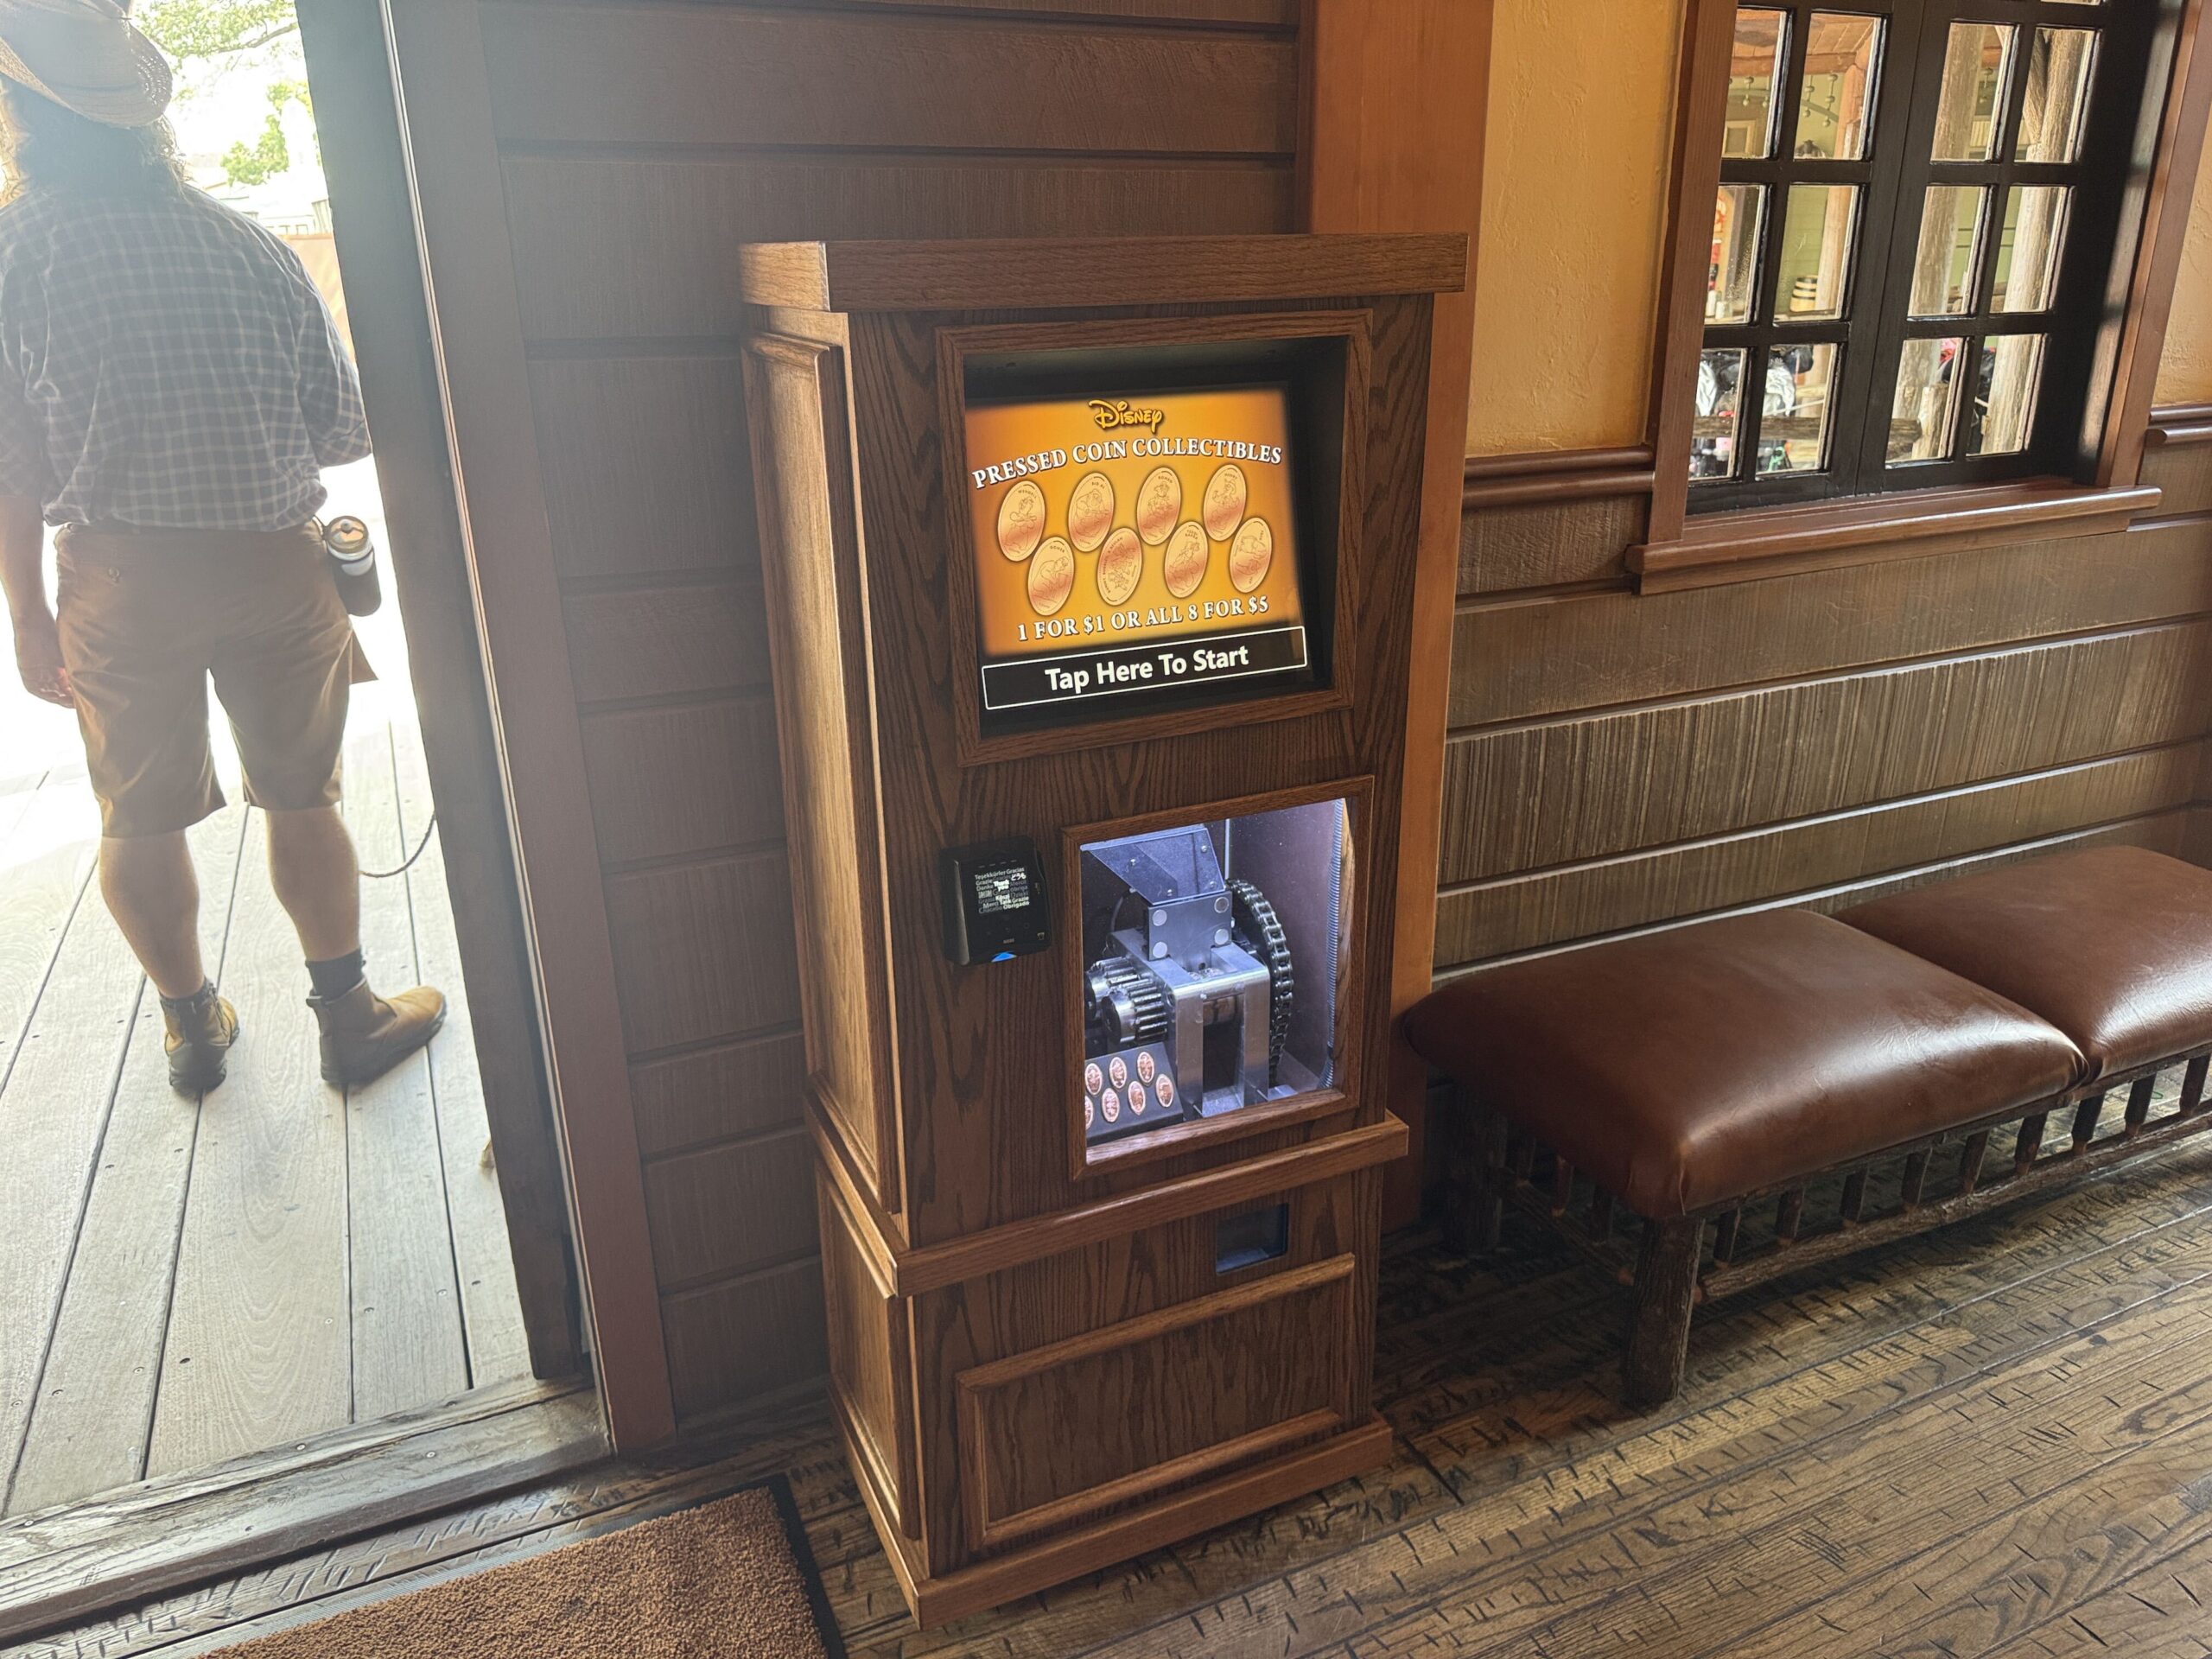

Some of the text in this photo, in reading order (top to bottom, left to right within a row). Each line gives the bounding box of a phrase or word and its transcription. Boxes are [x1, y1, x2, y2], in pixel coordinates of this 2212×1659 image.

[1089, 400, 1163, 434] Disney
[972, 438, 1282, 489] PRESSED COIN COLLECTIBLES
[1018, 595, 1268, 641] 1 FOR $1 OR ALL 8 FOR $5
[1045, 645, 1249, 694] Tap Here To Start
